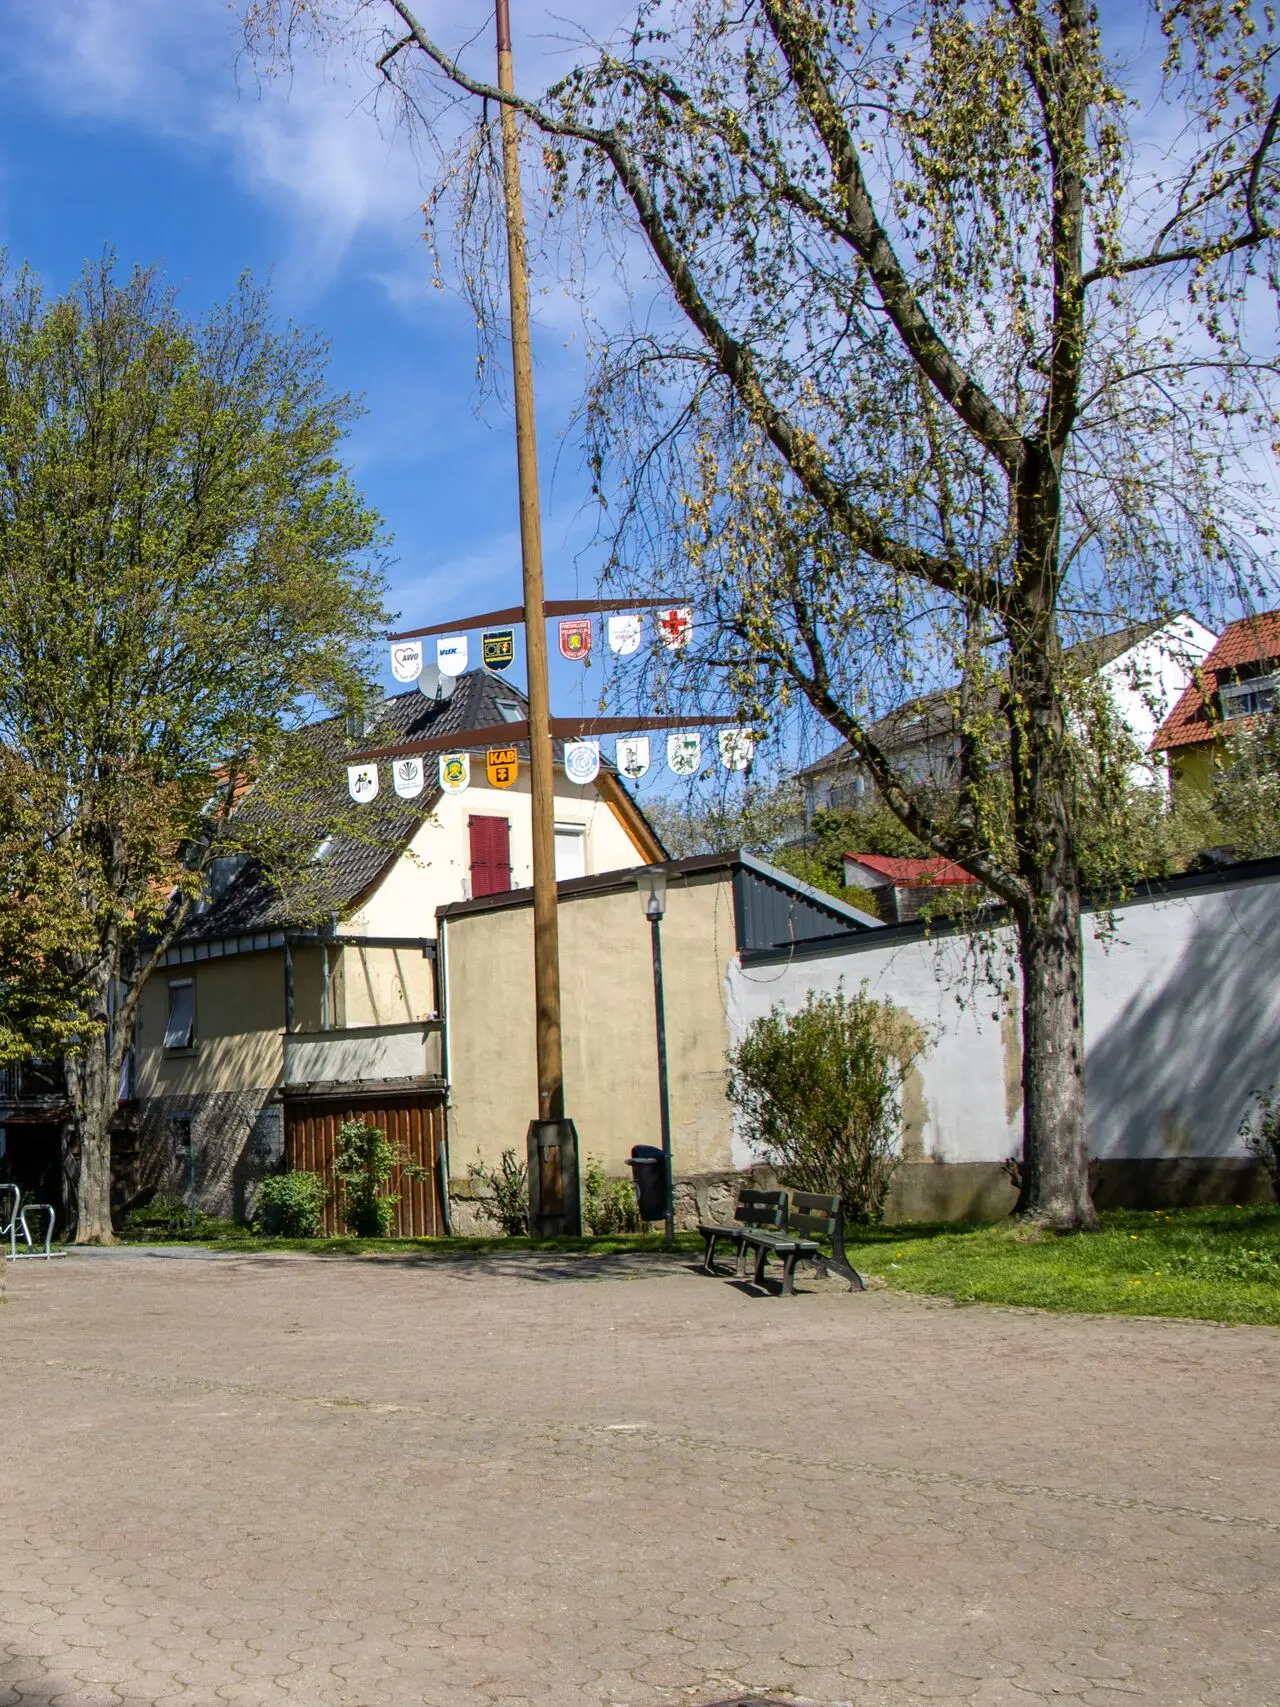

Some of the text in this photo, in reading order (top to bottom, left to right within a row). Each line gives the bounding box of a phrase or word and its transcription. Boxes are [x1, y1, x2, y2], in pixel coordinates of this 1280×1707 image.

[439, 647, 458, 656] VdK
[402, 653, 419, 662] AWO
[490, 751, 515, 764] KAB
